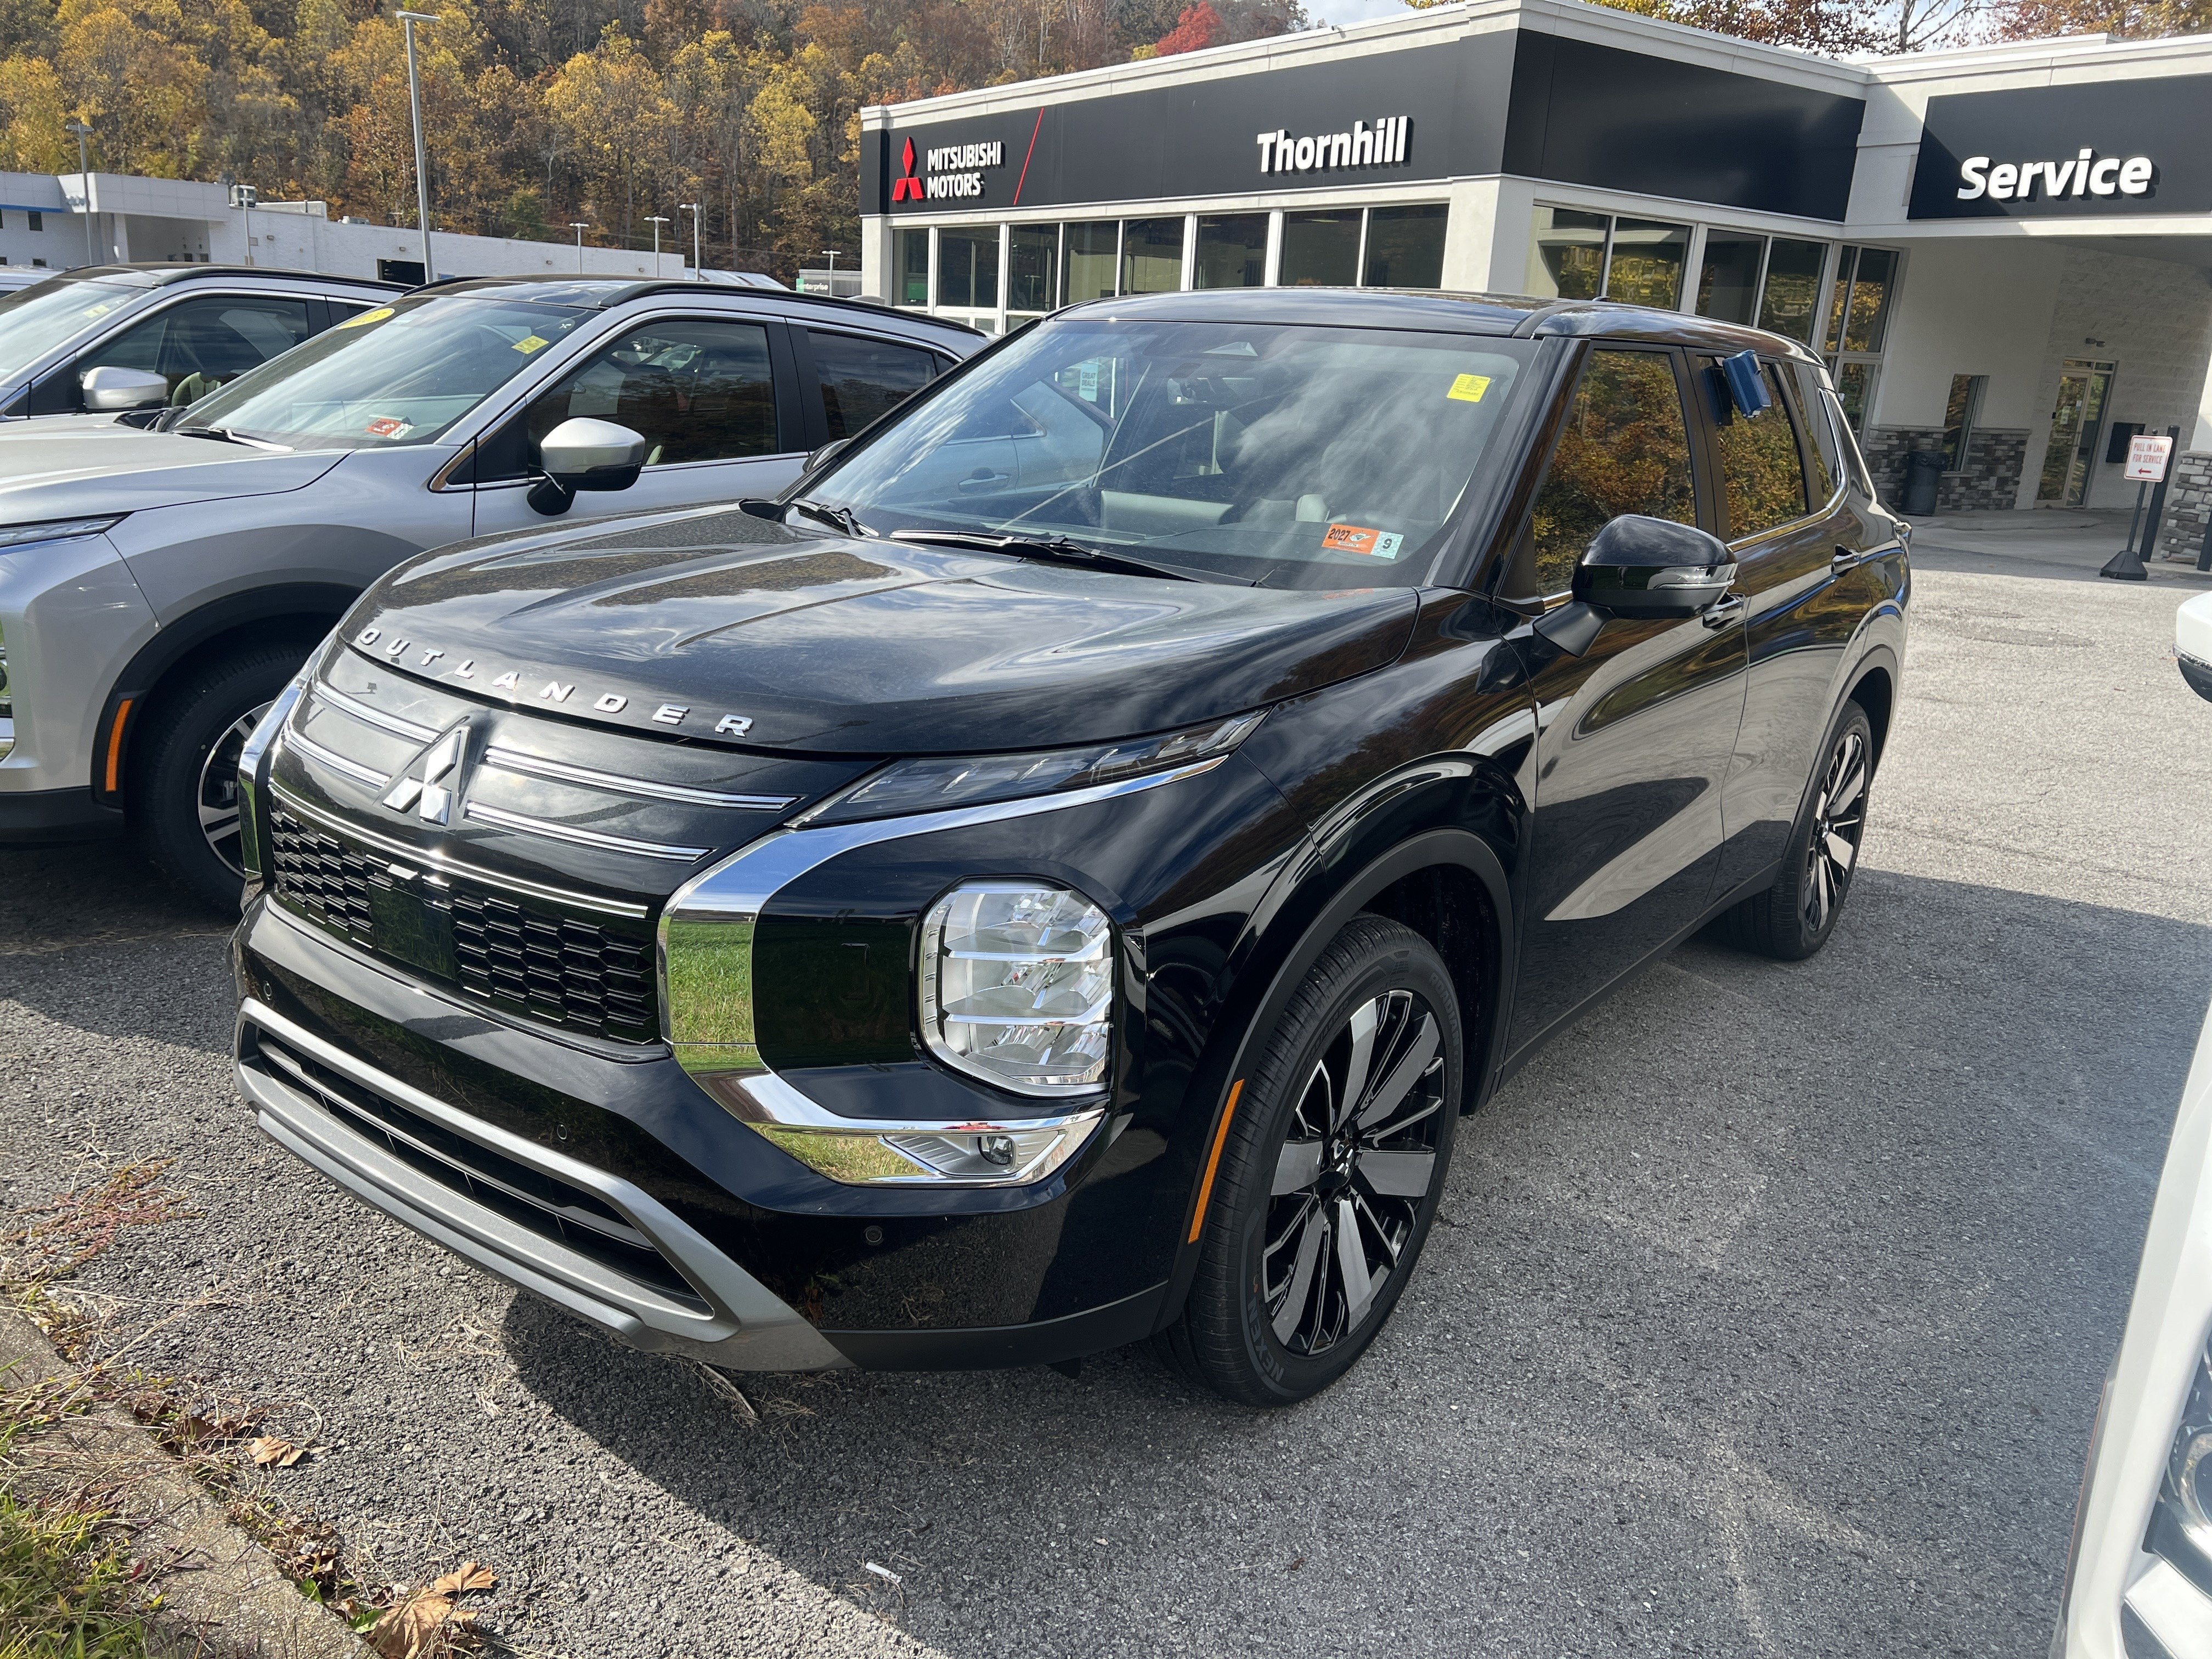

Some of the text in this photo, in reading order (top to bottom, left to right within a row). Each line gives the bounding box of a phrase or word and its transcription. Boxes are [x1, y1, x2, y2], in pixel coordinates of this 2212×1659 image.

[927, 141, 1002, 171] MITSUBISHI
[1257, 115, 1408, 172] Thornhill
[927, 172, 981, 199] MOTORS
[1957, 148, 2152, 200] Service
[2133, 454, 2163, 464] FOR SERVICE
[2134, 443, 2166, 453] PULL IN LANE
[1328, 528, 1351, 541] 2027
[1382, 538, 1392, 549] 9
[359, 627, 754, 738] OUTLANDER
[1248, 1296, 1285, 1383] NEXEN
